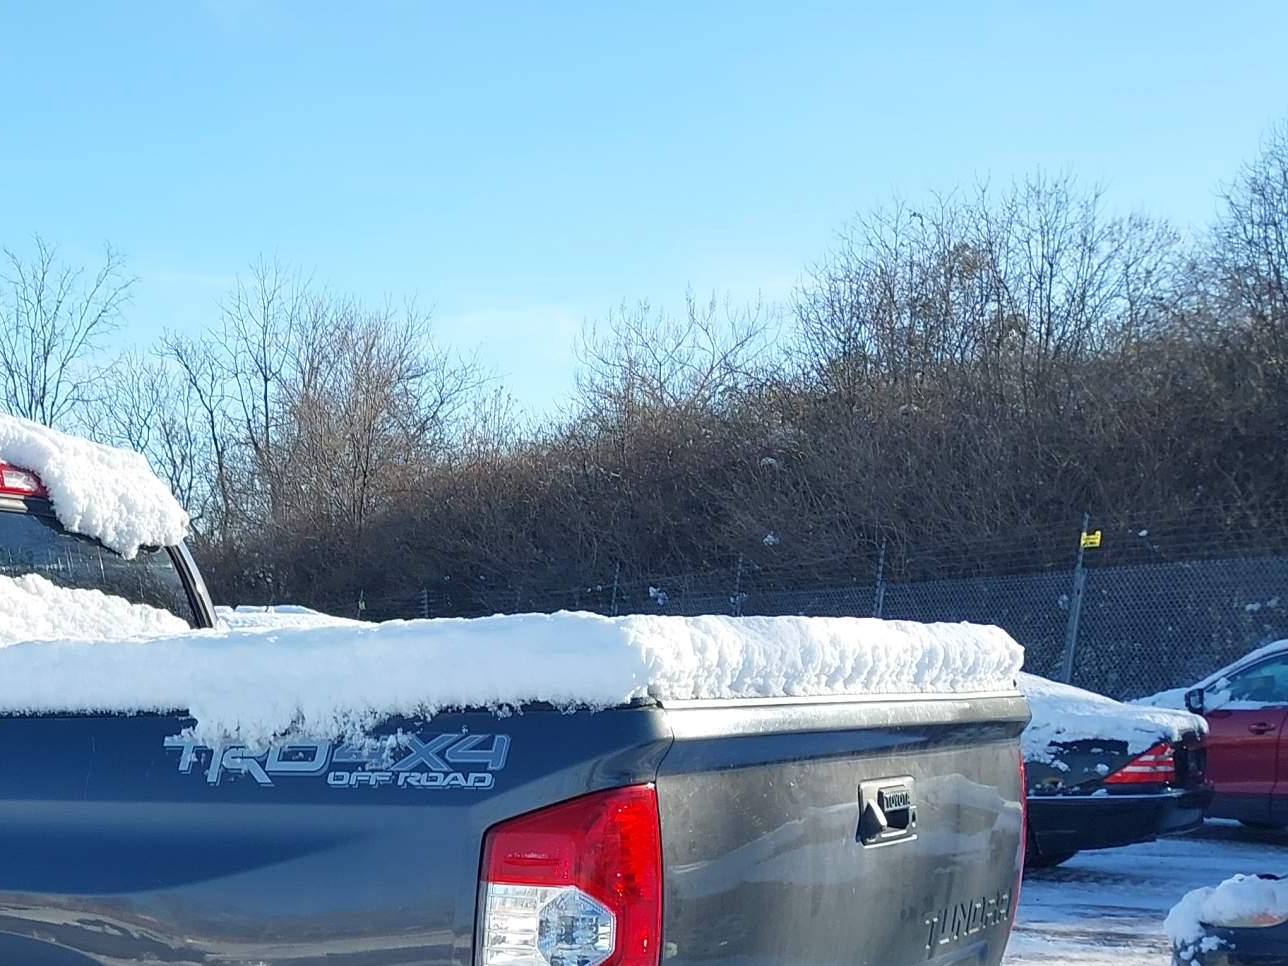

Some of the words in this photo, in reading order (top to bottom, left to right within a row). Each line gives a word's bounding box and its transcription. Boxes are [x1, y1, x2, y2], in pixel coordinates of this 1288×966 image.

[163, 734, 330, 787] TRD
[327, 771, 393, 788] OFF
[397, 772, 495, 790] ROAD
[923, 889, 1012, 950] TUNDRA
